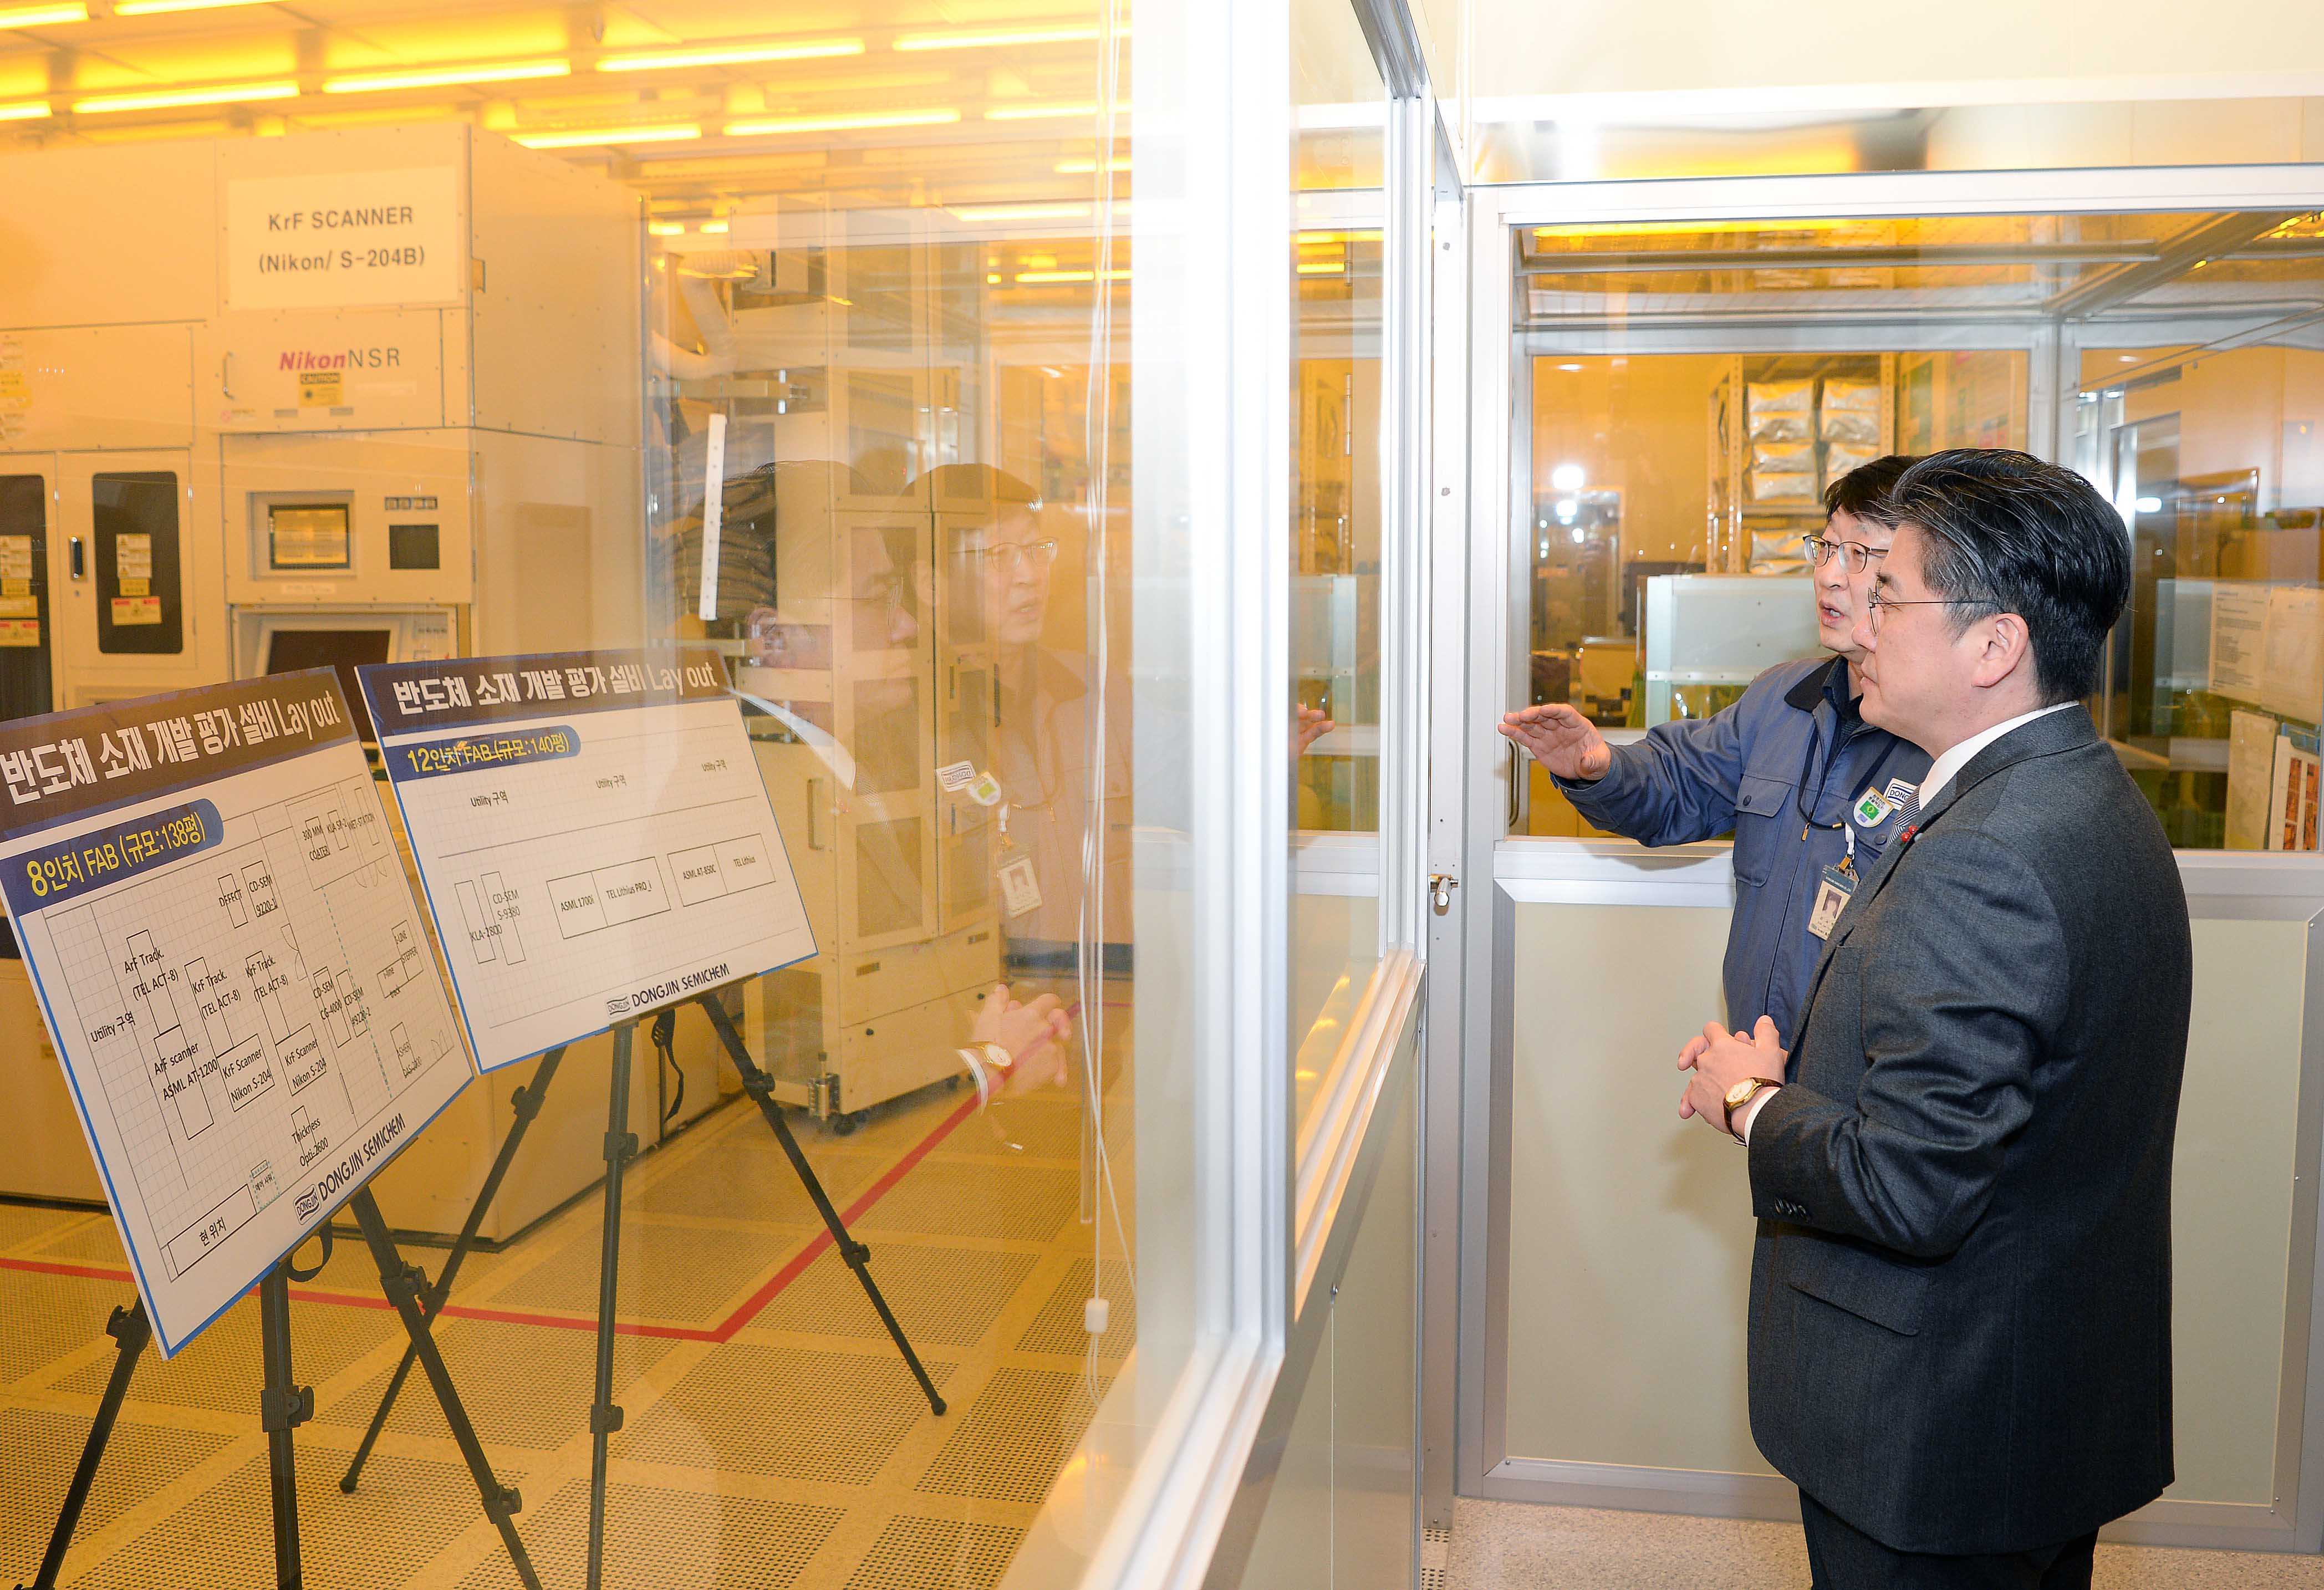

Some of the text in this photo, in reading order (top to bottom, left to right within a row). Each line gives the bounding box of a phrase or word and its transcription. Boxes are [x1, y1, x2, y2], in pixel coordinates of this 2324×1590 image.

[268, 206, 413, 231] KrF SCANNER
[259, 245, 425, 273] (Nikon/ S-204B)
[280, 347, 400, 370] Nikon NSR
[393, 661, 718, 715] 반도체 소재 개발 평가 설비 Lay out
[0, 690, 342, 805] 반도체 소재 개발 평가 설비 Lay out
[407, 731, 570, 772] 12인치 FAB (규모:140평)
[596, 778, 613, 789] Utility
[1889, 789, 1909, 801] DONG
[470, 790, 508, 807] Utility 구역
[27, 811, 206, 896] 8인치 FAB (규모:138평)
[248, 874, 273, 893] CD-SEM
[492, 889, 519, 905] CD-SEM
[606, 889, 618, 900] TEL
[218, 889, 243, 907] DEFECT
[560, 899, 578, 912] ASML
[497, 906, 521, 921] S-9380
[124, 947, 165, 974] ArF Track.
[245, 955, 276, 978] KrF Track.
[132, 968, 179, 1001] (TEL ACT-8)
[192, 969, 228, 994] KrF Track.
[253, 973, 289, 1002] (TEL ACT-8)
[313, 978, 334, 999] CD-SEM
[631, 962, 730, 1007] DONGJIN SEMICHEM
[201, 988, 241, 1020] (TEL ACT-8)
[344, 986, 364, 1006] CD-SEM
[90, 1011, 136, 1042] Utility 구역
[154, 1042, 199, 1076] ArF scanner
[222, 1049, 263, 1079] KrF Scanner
[284, 1038, 319, 1067] KrF Scanner
[163, 1058, 218, 1101] ASML AT-1200
[230, 1068, 272, 1103] Nikon S-204
[292, 1071, 311, 1089] Nikon
[291, 1118, 321, 1145] Thickness
[318, 1113, 406, 1201] DONGJIN SEMICHEM
[296, 1192, 319, 1217] DONGJIN
[199, 1216, 227, 1247] 현 위치
